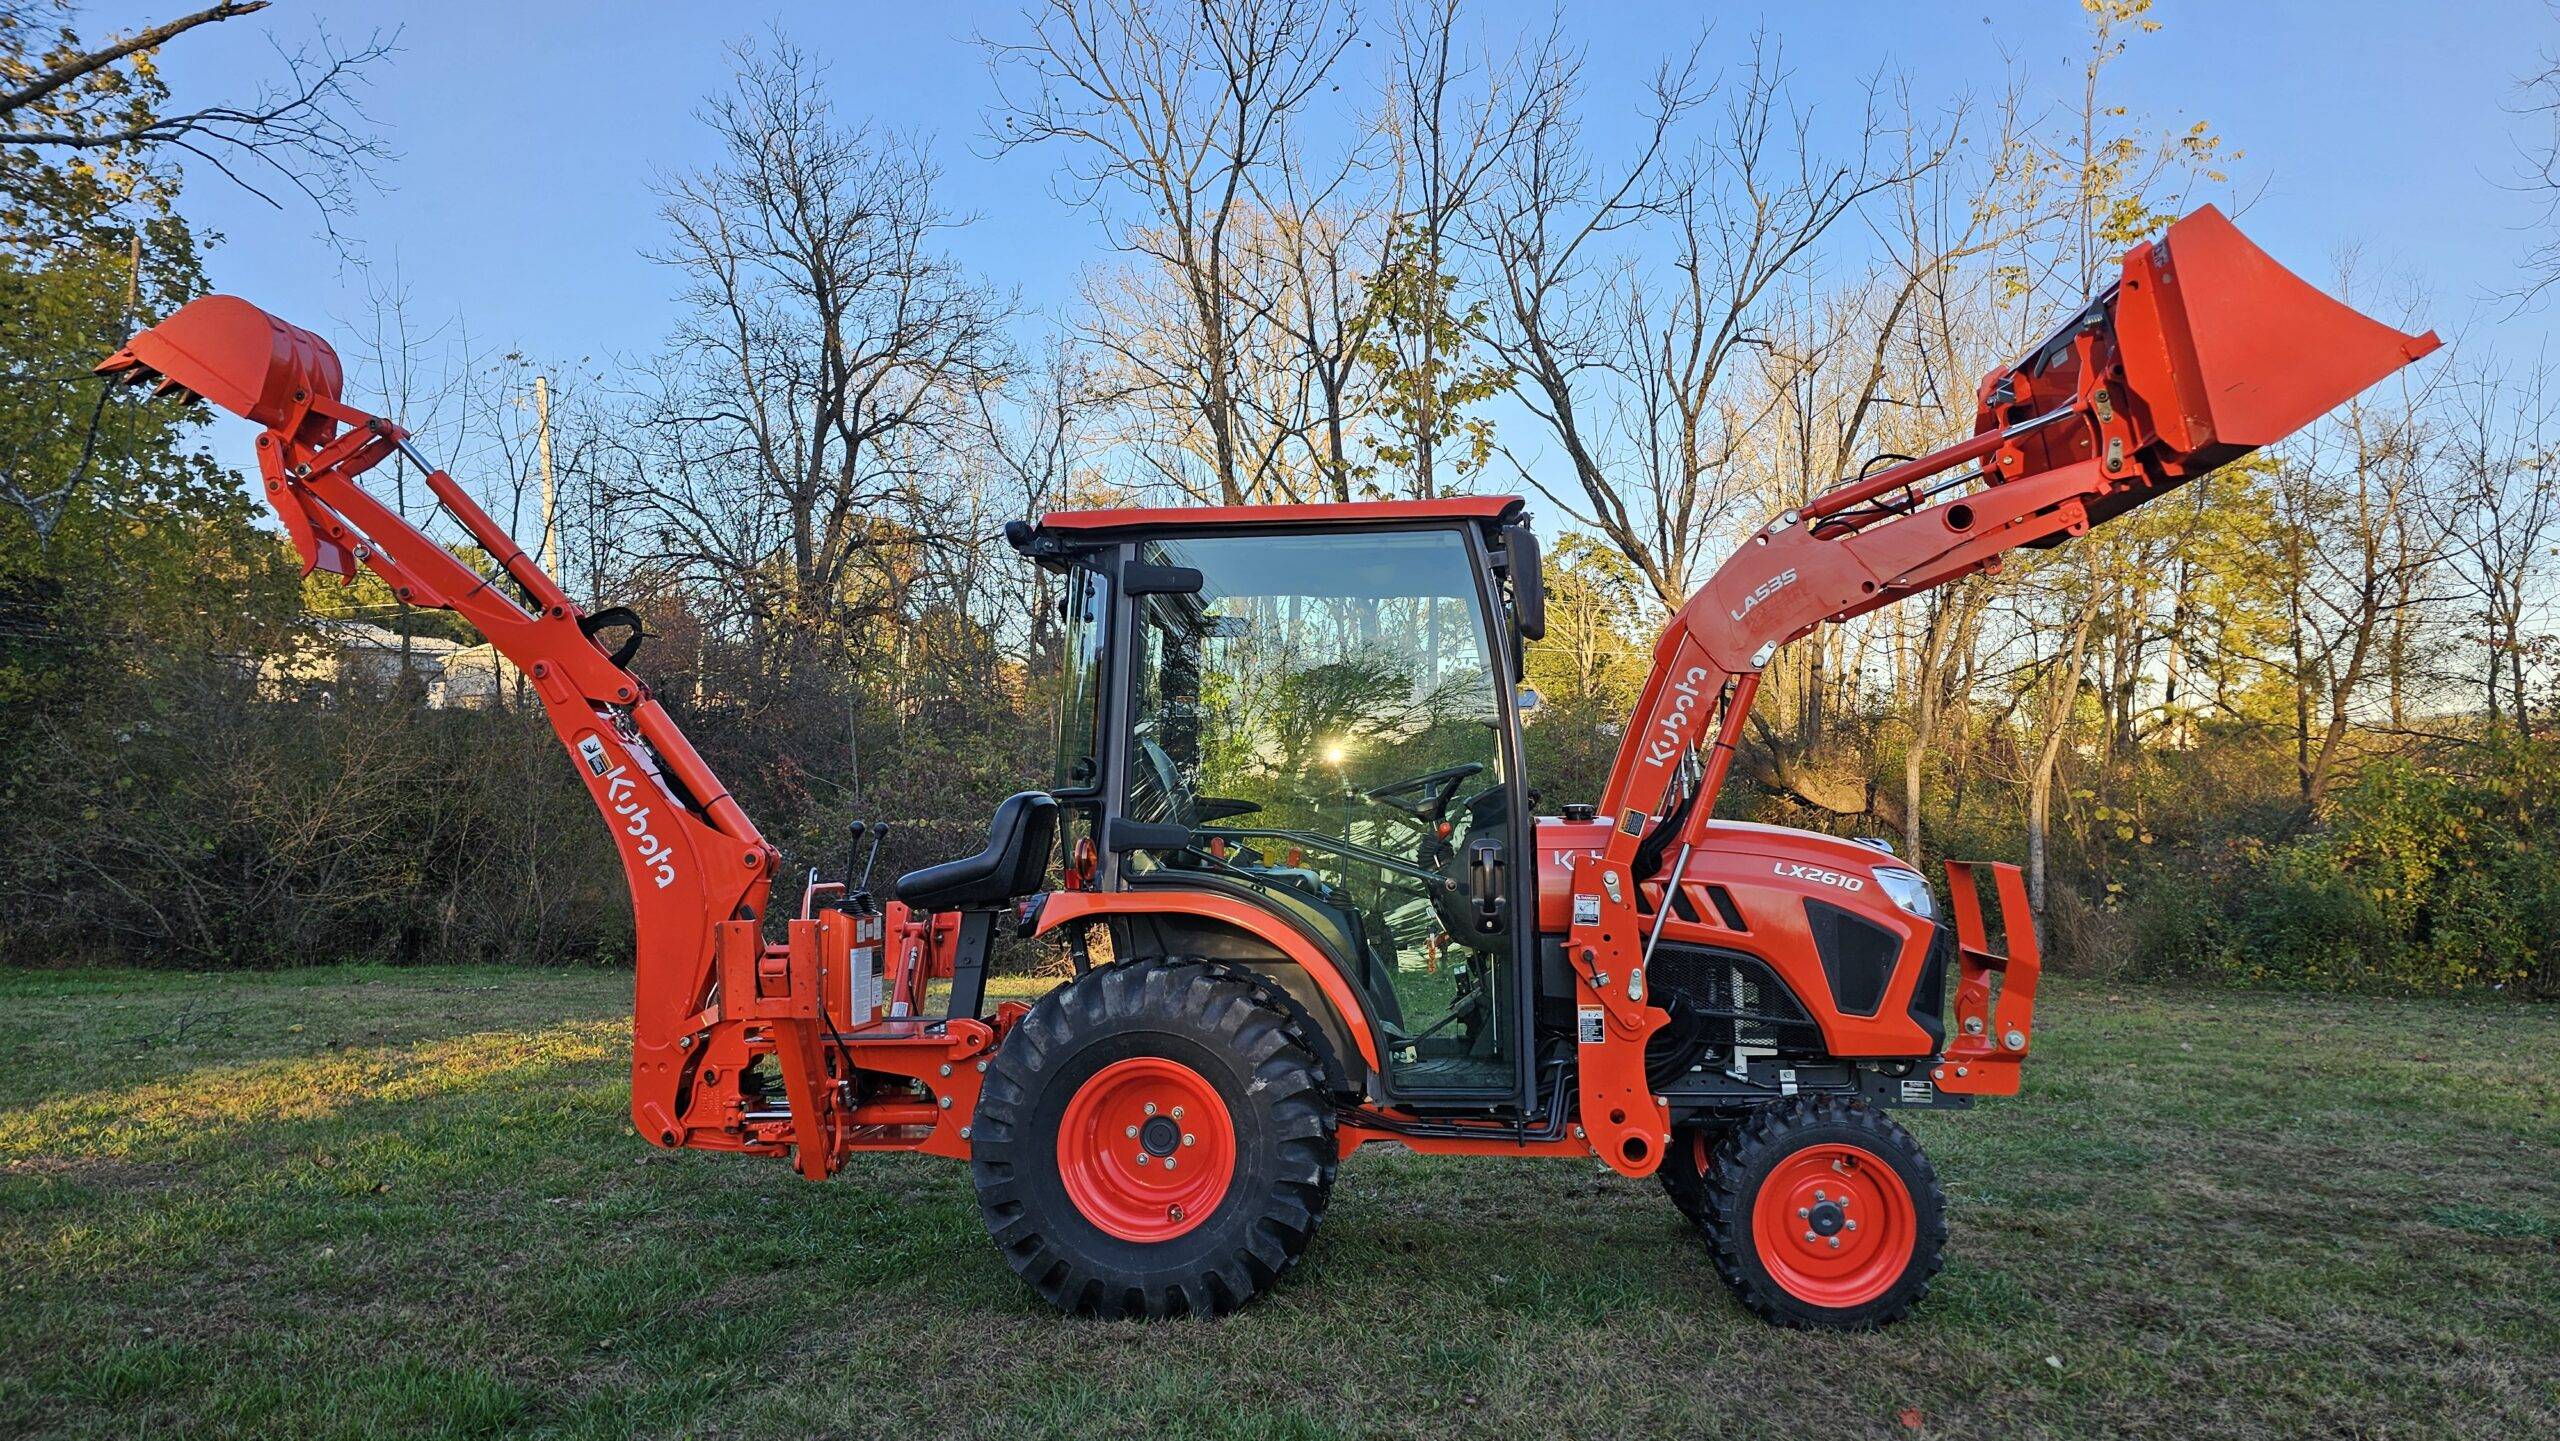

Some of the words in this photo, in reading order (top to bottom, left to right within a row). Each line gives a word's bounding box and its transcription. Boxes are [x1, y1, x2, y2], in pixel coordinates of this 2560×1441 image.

[1731, 568, 1797, 621] LA535
[1645, 667, 1707, 767] Kubota
[604, 765, 675, 889] Kubota
[1774, 862, 1863, 891] LX2610
